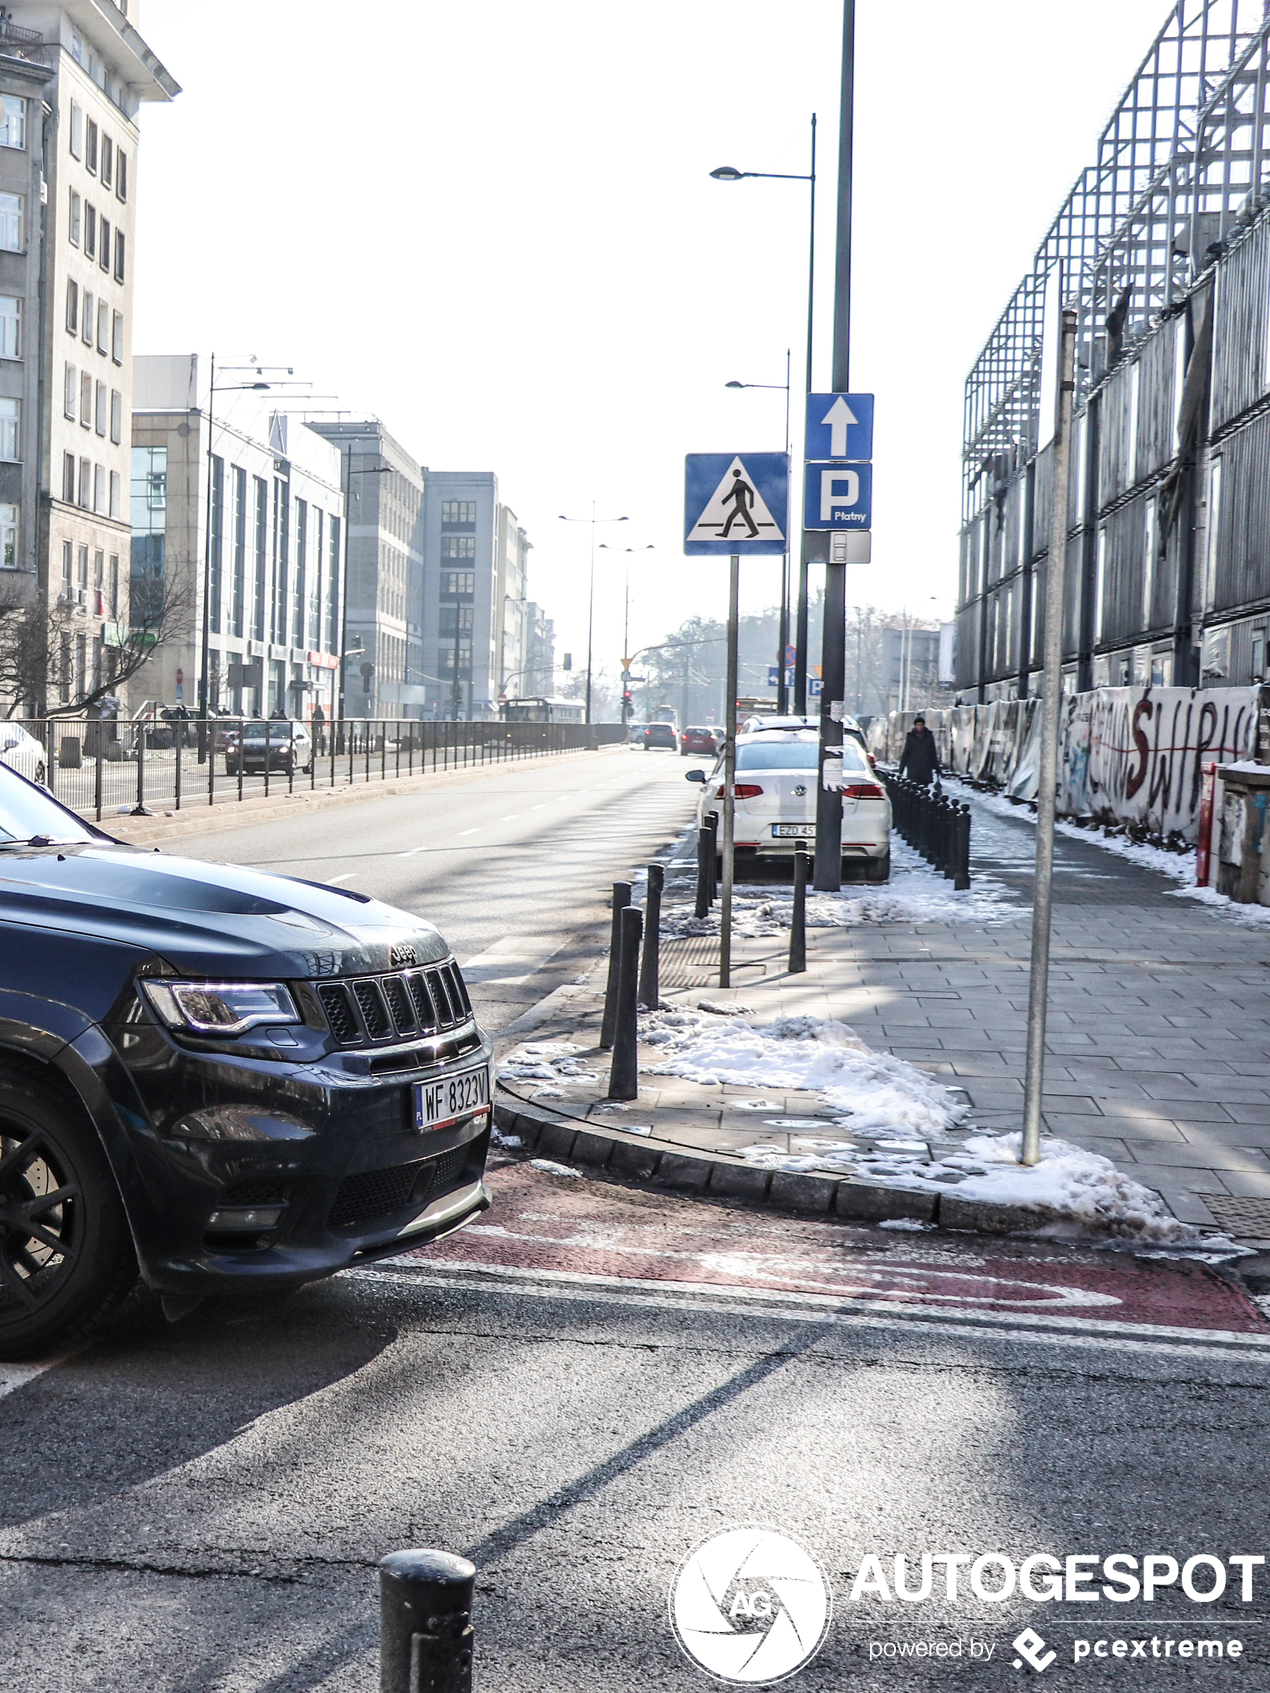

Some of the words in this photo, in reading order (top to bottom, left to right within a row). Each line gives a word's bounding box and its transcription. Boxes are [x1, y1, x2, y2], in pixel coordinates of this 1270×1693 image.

[820, 470, 859, 520] P
[835, 511, 866, 523] Płatny
[802, 826, 817, 835] 45
[390, 943, 418, 965] Jeep
[426, 1084, 444, 1121] WF
[449, 1072, 485, 1113] 8323V
